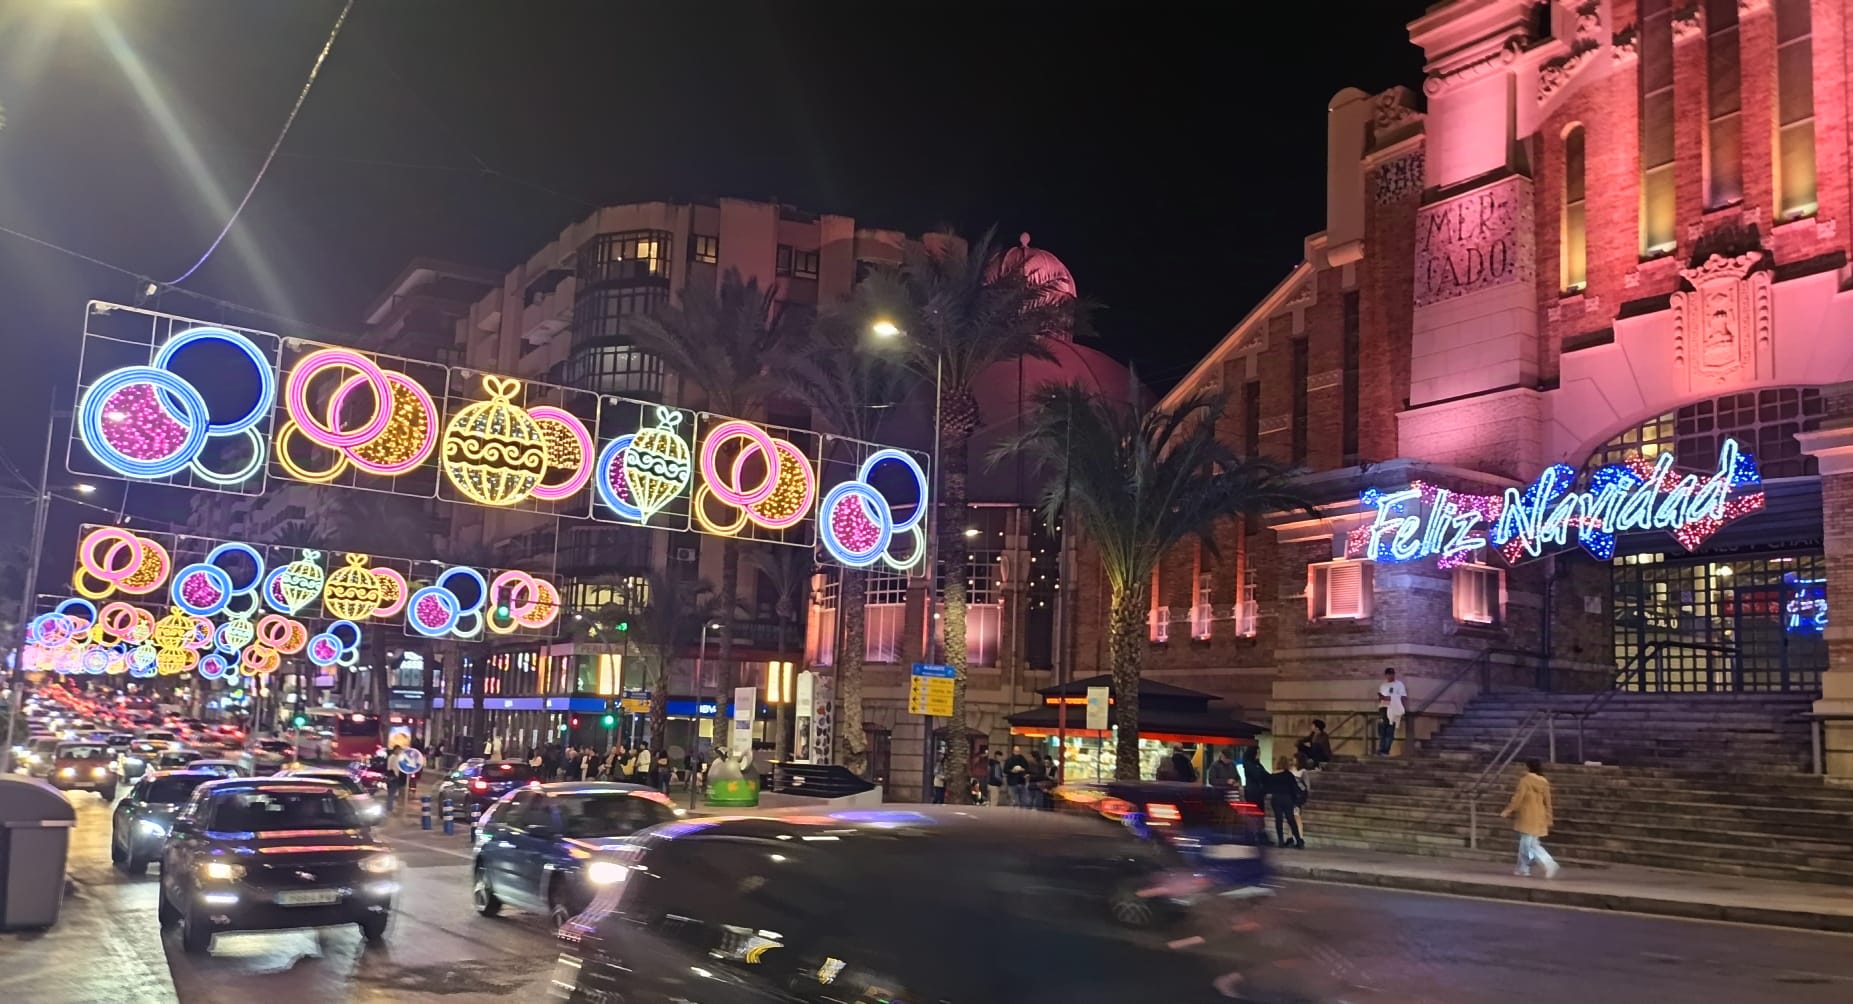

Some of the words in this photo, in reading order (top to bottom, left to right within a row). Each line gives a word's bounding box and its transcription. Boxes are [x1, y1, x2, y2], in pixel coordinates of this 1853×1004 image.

[1426, 239, 1507, 296] CADO
[1366, 488, 1487, 560] Feliz
[1491, 438, 1739, 557] Navidad
